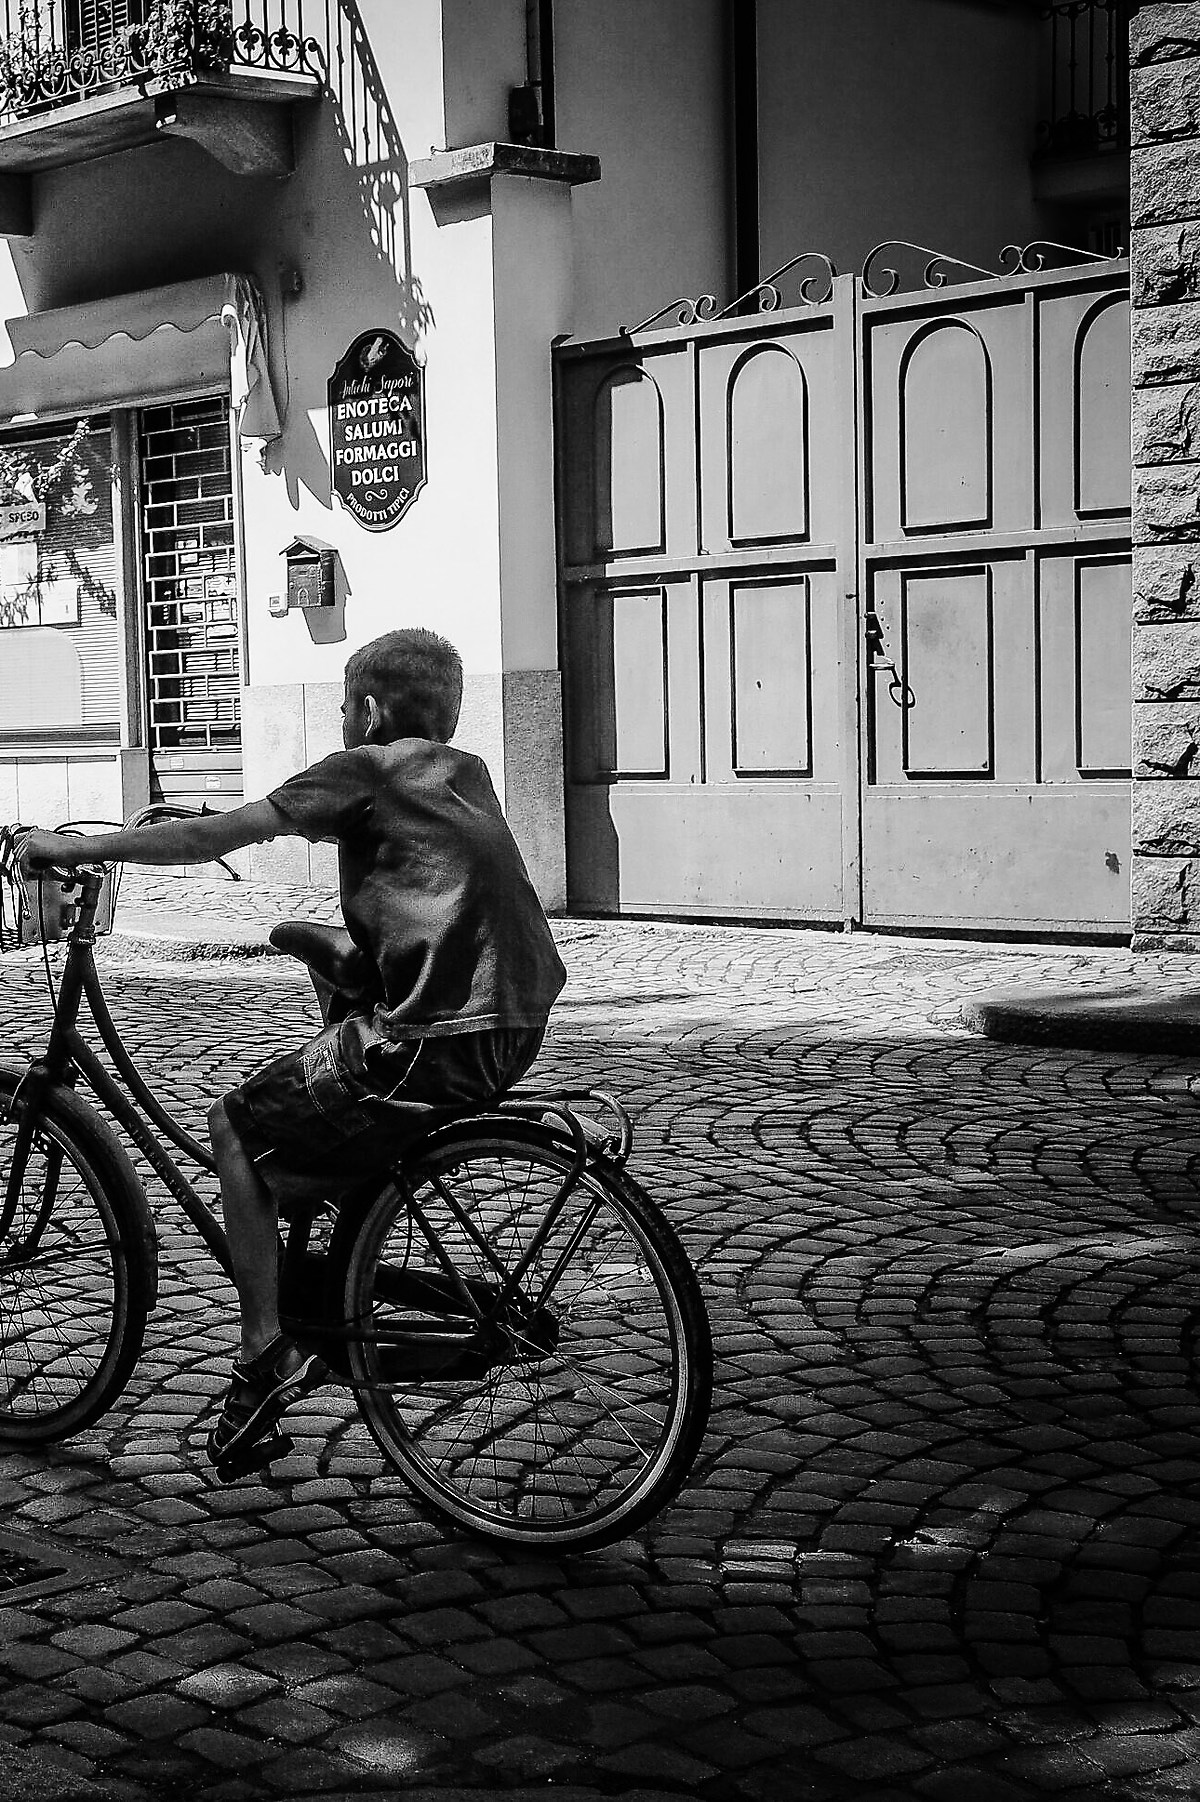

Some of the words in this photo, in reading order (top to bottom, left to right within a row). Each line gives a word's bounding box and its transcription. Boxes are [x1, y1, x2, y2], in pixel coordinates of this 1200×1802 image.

[375, 372, 414, 395] Sapori
[336, 395, 413, 421] ENOTECA
[344, 419, 403, 441] SALUMI
[335, 440, 418, 466] FORMAGGI
[351, 466, 399, 486] DOLCI
[346, 491, 388, 523] PRODOTTI
[387, 486, 410, 515] TIPICI
